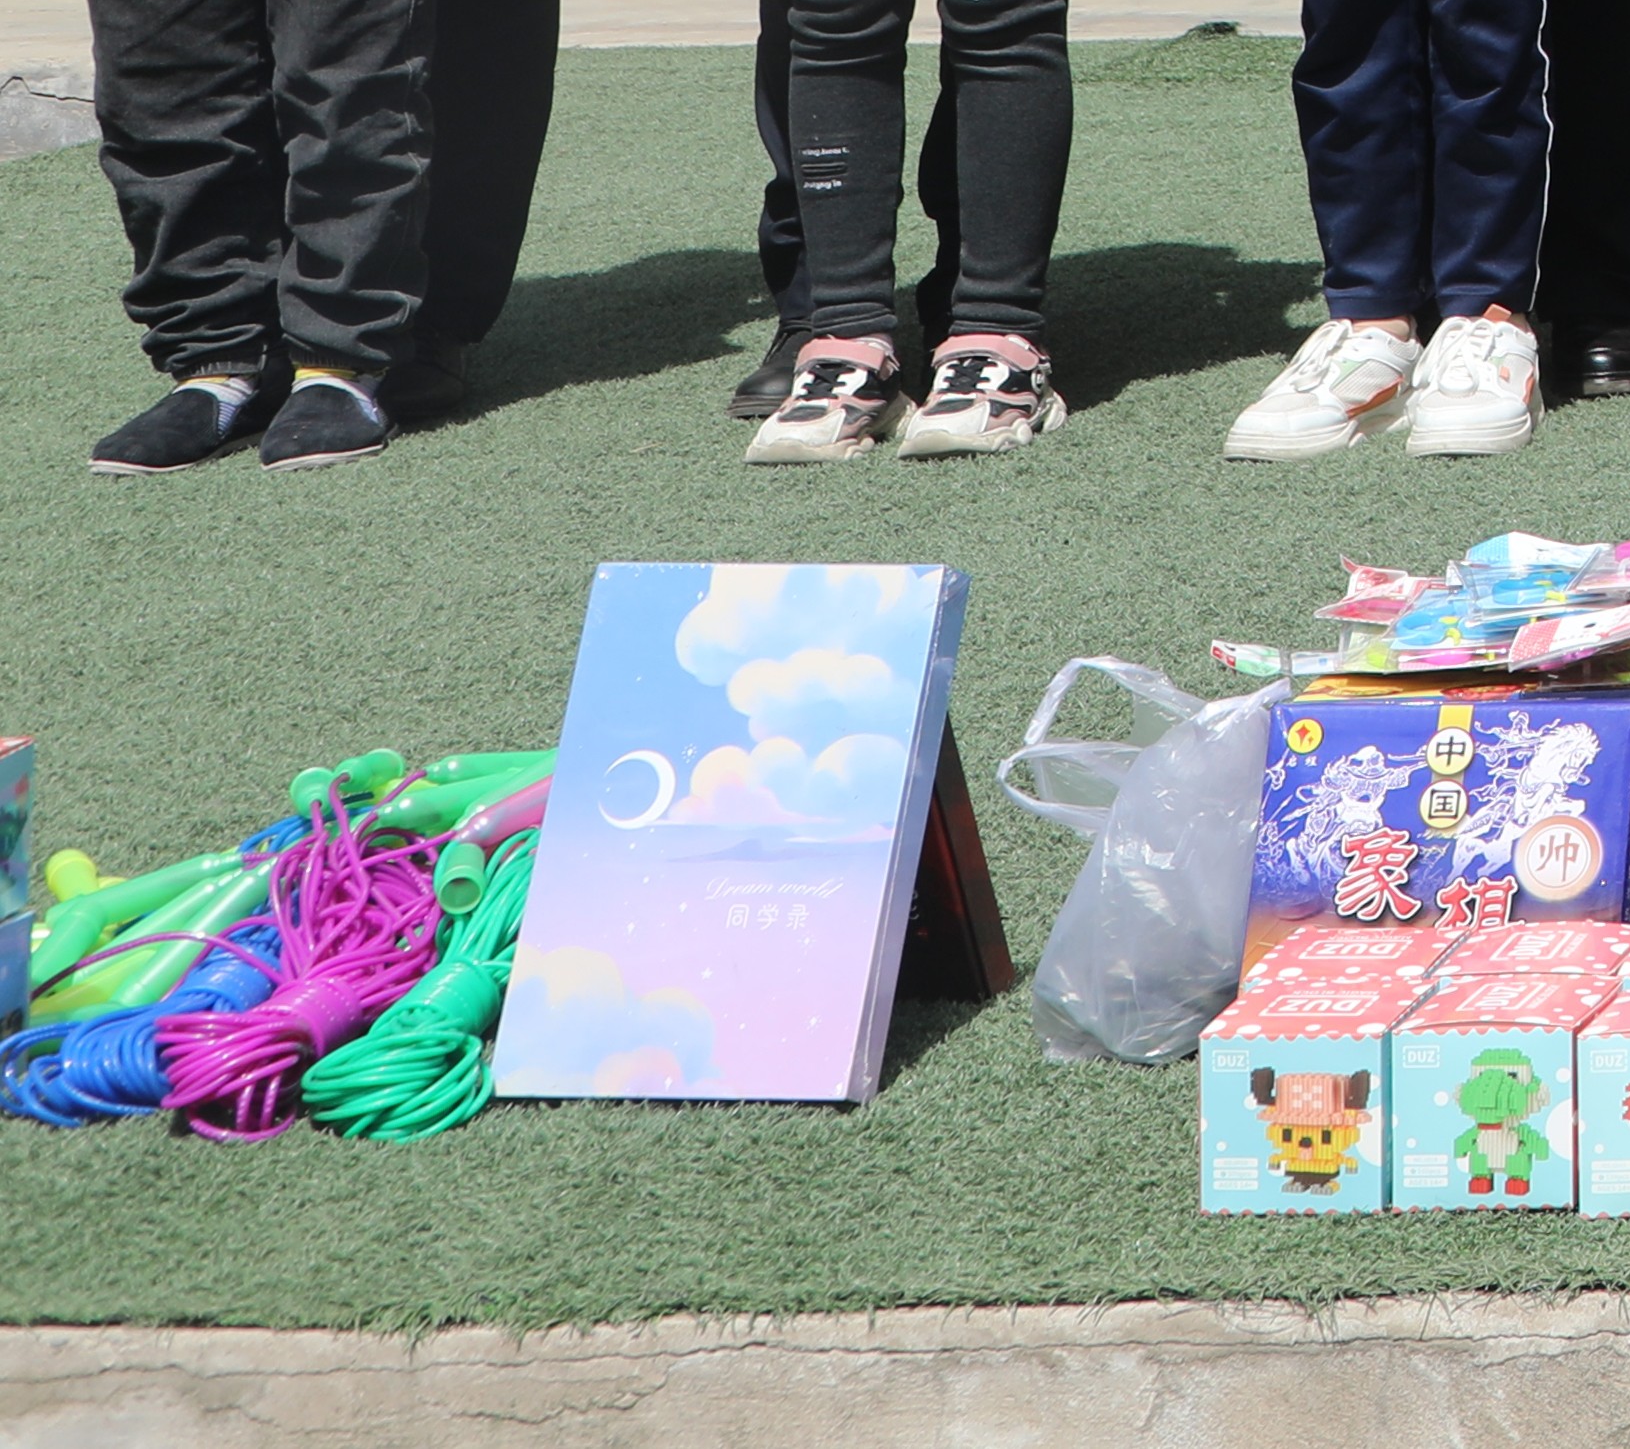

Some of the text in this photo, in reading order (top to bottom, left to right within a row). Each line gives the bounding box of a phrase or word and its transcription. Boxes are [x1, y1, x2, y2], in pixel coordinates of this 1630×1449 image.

[1428, 735, 1467, 820] 中国
[1539, 832, 1580, 883] 帅
[704, 875, 845, 901] Dream world
[1333, 826, 1529, 934] 象棋
[725, 904, 811, 930] 同学录
[1316, 940, 1391, 956] DUZ
[1277, 997, 1356, 1013] DUZ
[1217, 1053, 1246, 1068] DUZ
[1407, 1050, 1436, 1064] DUZ
[1594, 1054, 1624, 1068] DUZ
